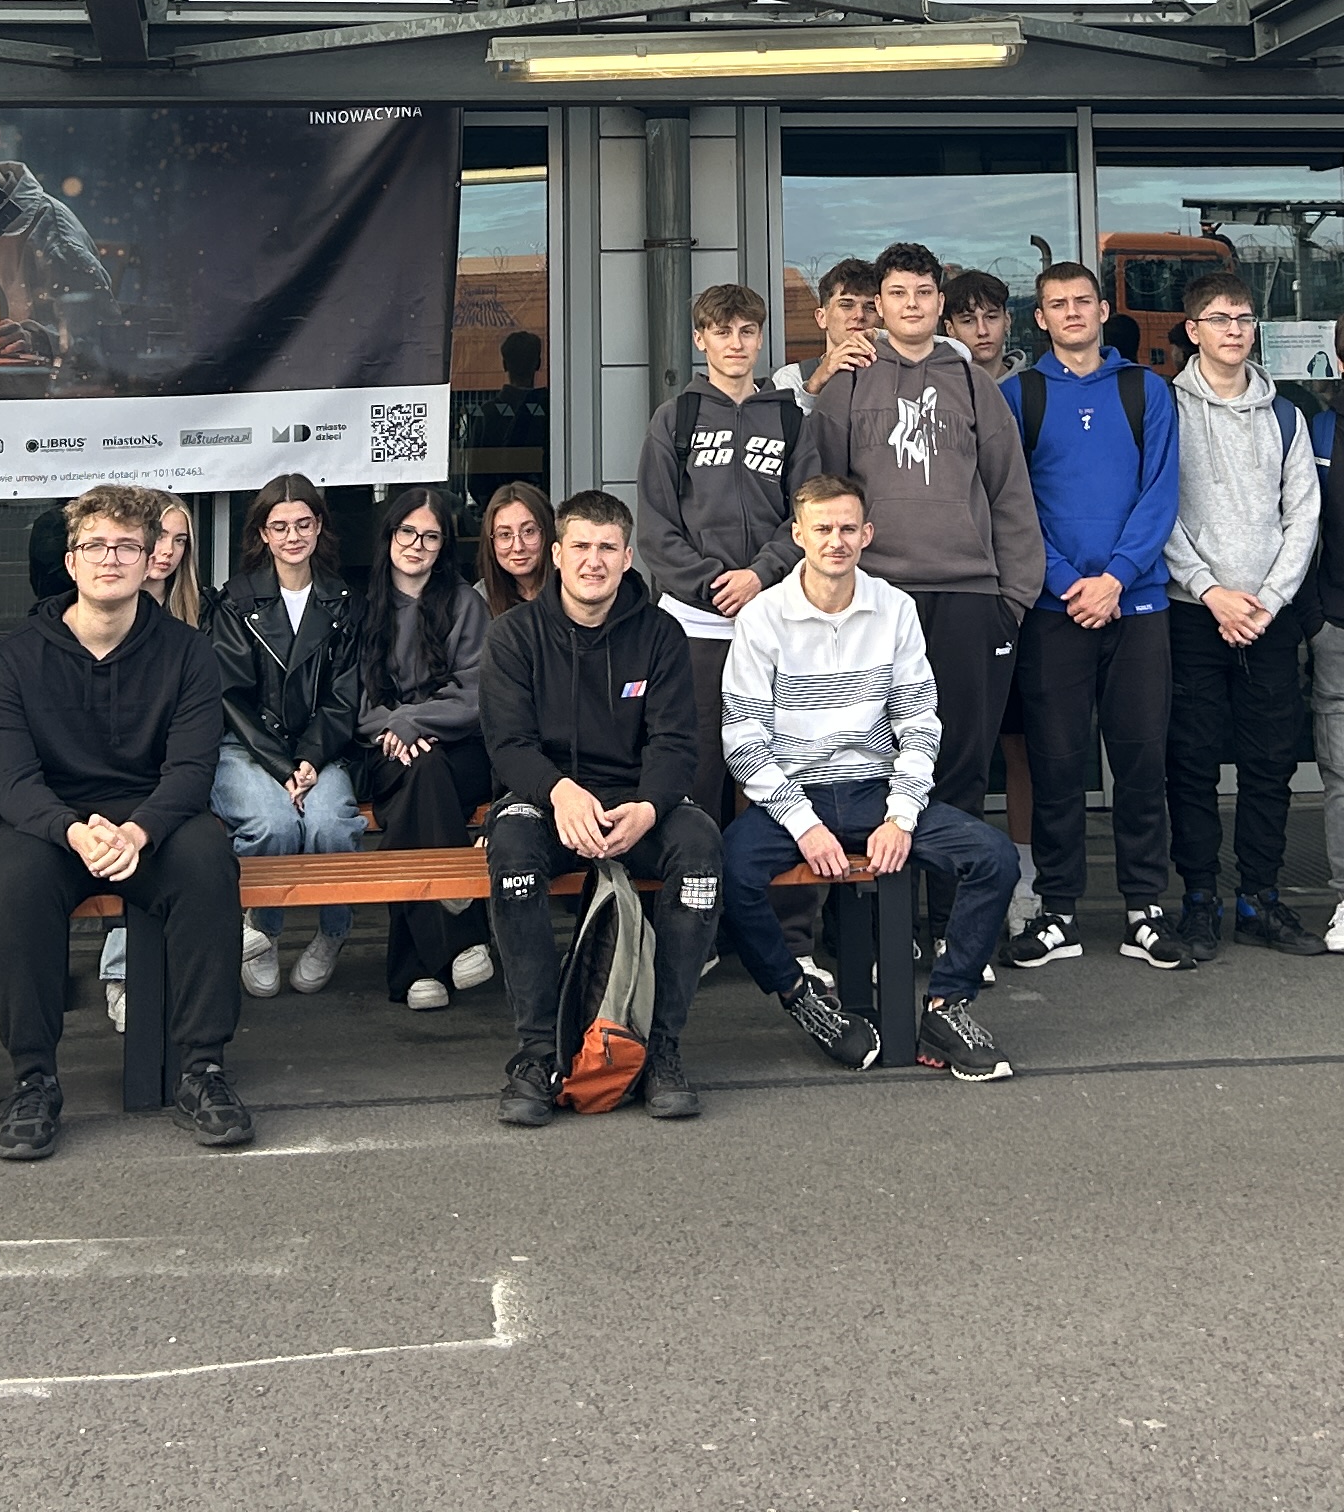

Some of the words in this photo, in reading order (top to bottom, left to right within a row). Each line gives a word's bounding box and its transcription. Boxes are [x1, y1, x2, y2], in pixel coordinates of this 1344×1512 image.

[309, 106, 423, 125] INNOWACYJNA
[315, 423, 348, 432] miasto
[315, 431, 342, 441] dzieci
[40, 438, 85, 449] LIBRUS
[16, 475, 49, 485] umowy
[108, 469, 139, 481] dotacji
[502, 873, 535, 889] MOVE
